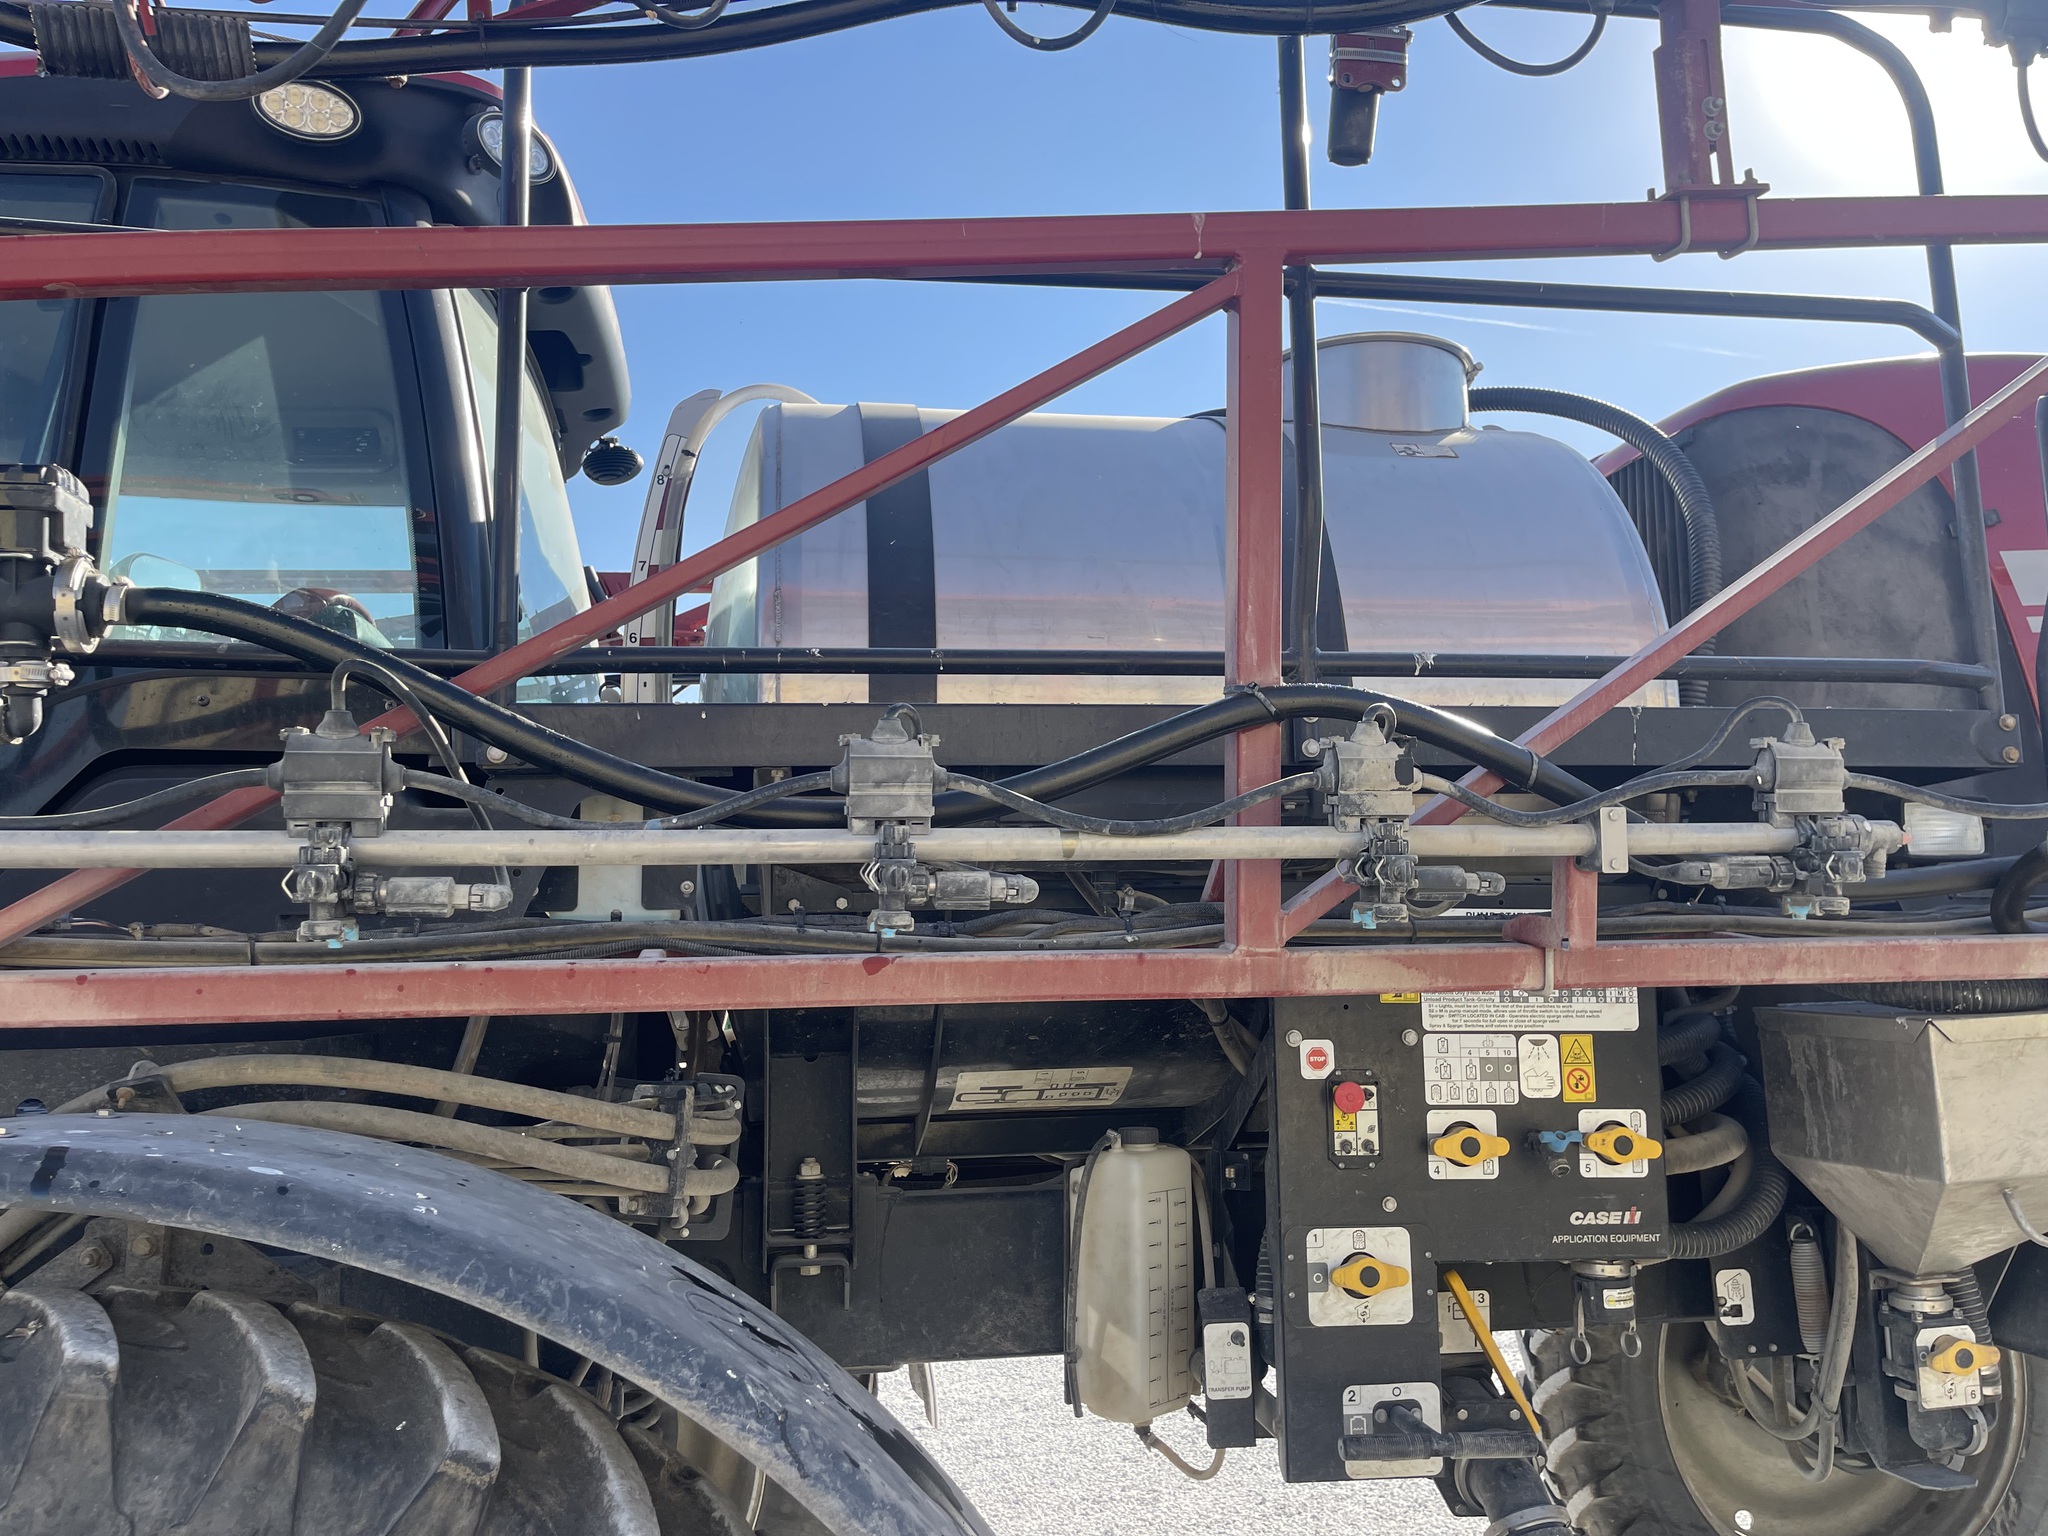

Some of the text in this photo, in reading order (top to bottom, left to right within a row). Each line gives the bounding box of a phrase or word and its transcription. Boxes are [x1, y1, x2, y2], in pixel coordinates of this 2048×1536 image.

[656, 474, 665, 486] 8
[638, 560, 647, 572] 7
[629, 632, 638, 644] 6
[1434, 1166, 1440, 1175] 4
[1585, 1164, 1591, 1173] 5
[1570, 1211, 1622, 1225] CASE
[1313, 1234, 1317, 1243] 1
[1552, 1234, 1660, 1244] APPLICATION EQUIPMENT
[1478, 1293, 1485, 1303] 3
[1348, 1390, 1356, 1402] 2
[1970, 1390, 1976, 1399] 6
